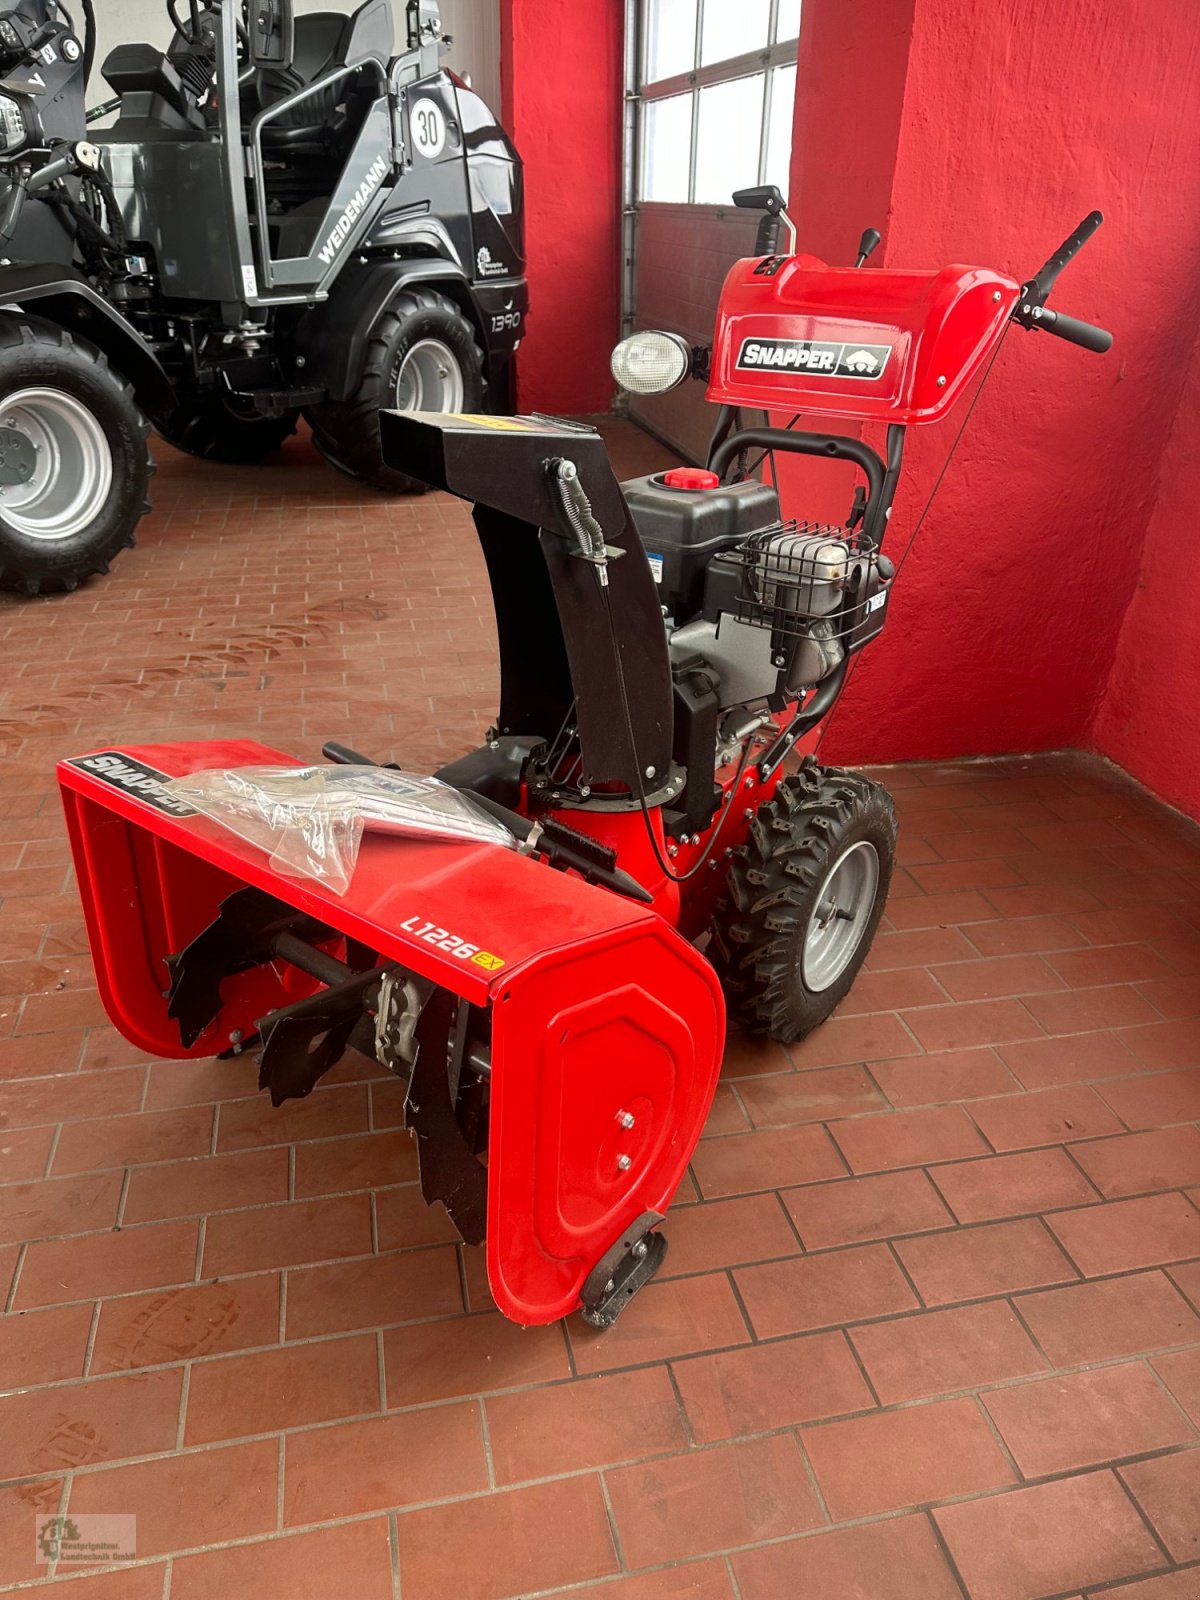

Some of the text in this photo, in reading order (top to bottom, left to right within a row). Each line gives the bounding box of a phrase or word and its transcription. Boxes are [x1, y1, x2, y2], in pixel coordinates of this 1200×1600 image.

[418, 110, 438, 146] 30
[318, 155, 387, 264] WEIDEMANN
[491, 312, 520, 332] 1390
[743, 343, 834, 370] SNAPPER
[400, 915, 502, 969] L1226 EX
